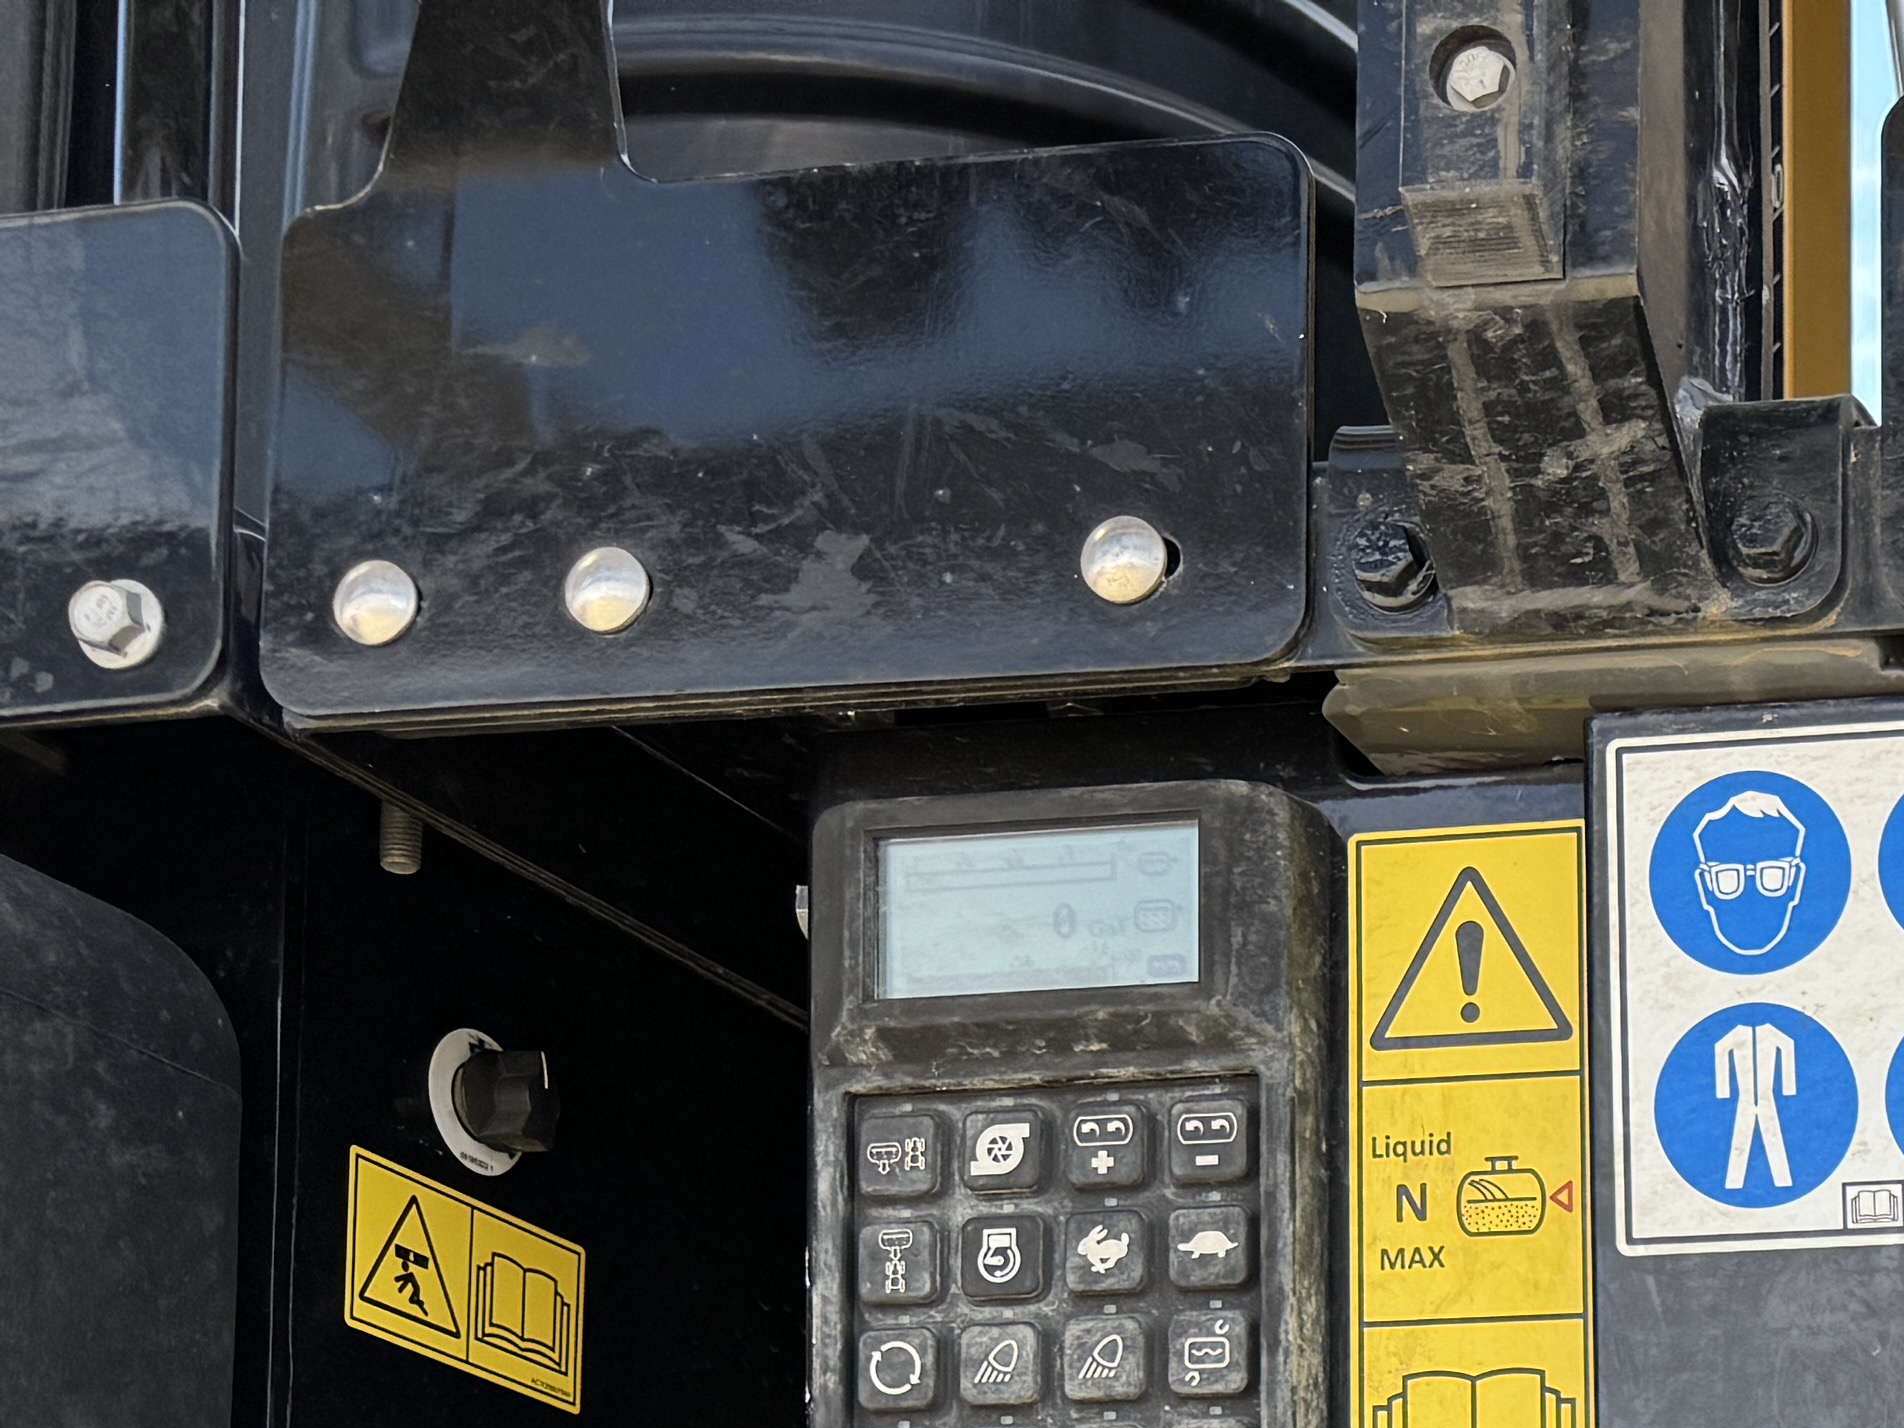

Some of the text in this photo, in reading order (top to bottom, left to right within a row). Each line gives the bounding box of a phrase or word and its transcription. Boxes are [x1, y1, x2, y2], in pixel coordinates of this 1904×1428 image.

[1371, 1131, 1452, 1163] Liquid
[1396, 1182, 1427, 1223] N
[1380, 1245, 1446, 1271] MAX
